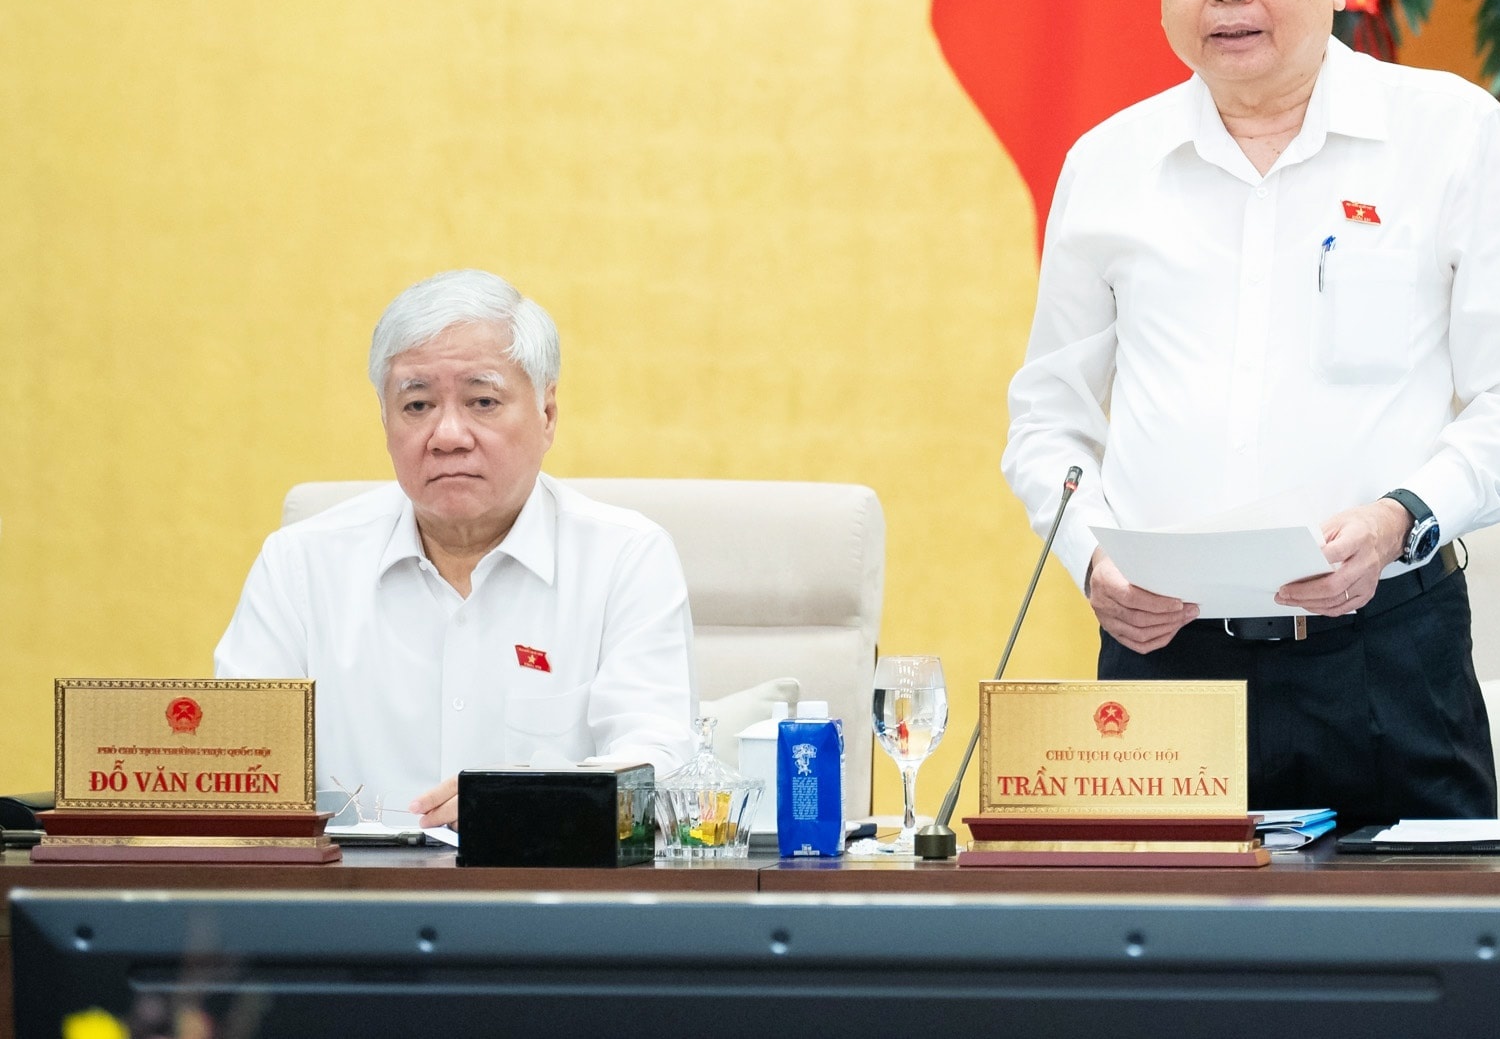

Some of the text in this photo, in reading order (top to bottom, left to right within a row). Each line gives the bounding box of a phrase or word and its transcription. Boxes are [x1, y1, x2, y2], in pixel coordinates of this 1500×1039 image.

[1045, 746, 1179, 763] CHỦ TỊCH QUỐC HỘI
[88, 759, 281, 794] ĐỖ VĂN CHIẾN
[997, 765, 1229, 797] TRẦN THANH MẪN
